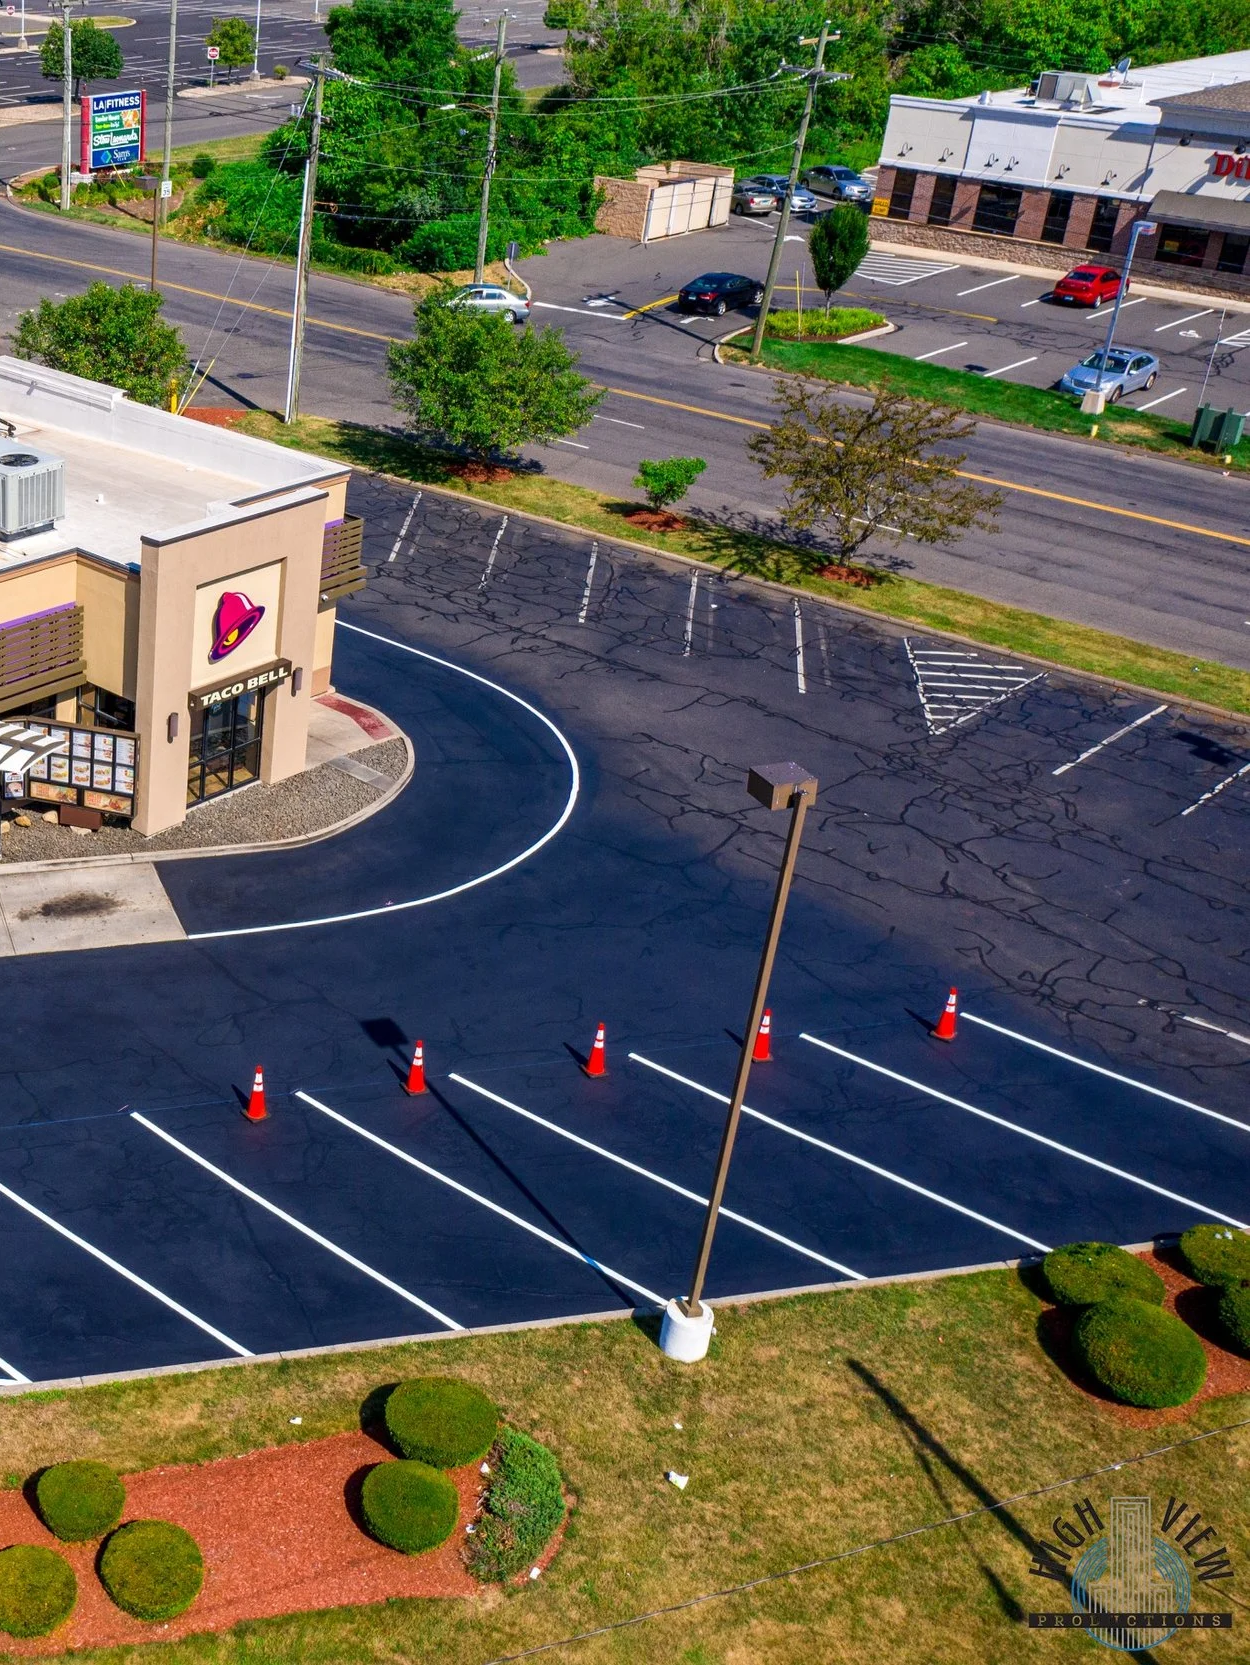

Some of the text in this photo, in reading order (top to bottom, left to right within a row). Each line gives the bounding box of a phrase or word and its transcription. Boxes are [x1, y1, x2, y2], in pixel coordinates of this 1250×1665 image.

[94, 96, 140, 110] LA FITNESS
[200, 667, 289, 707] TACO BELL
